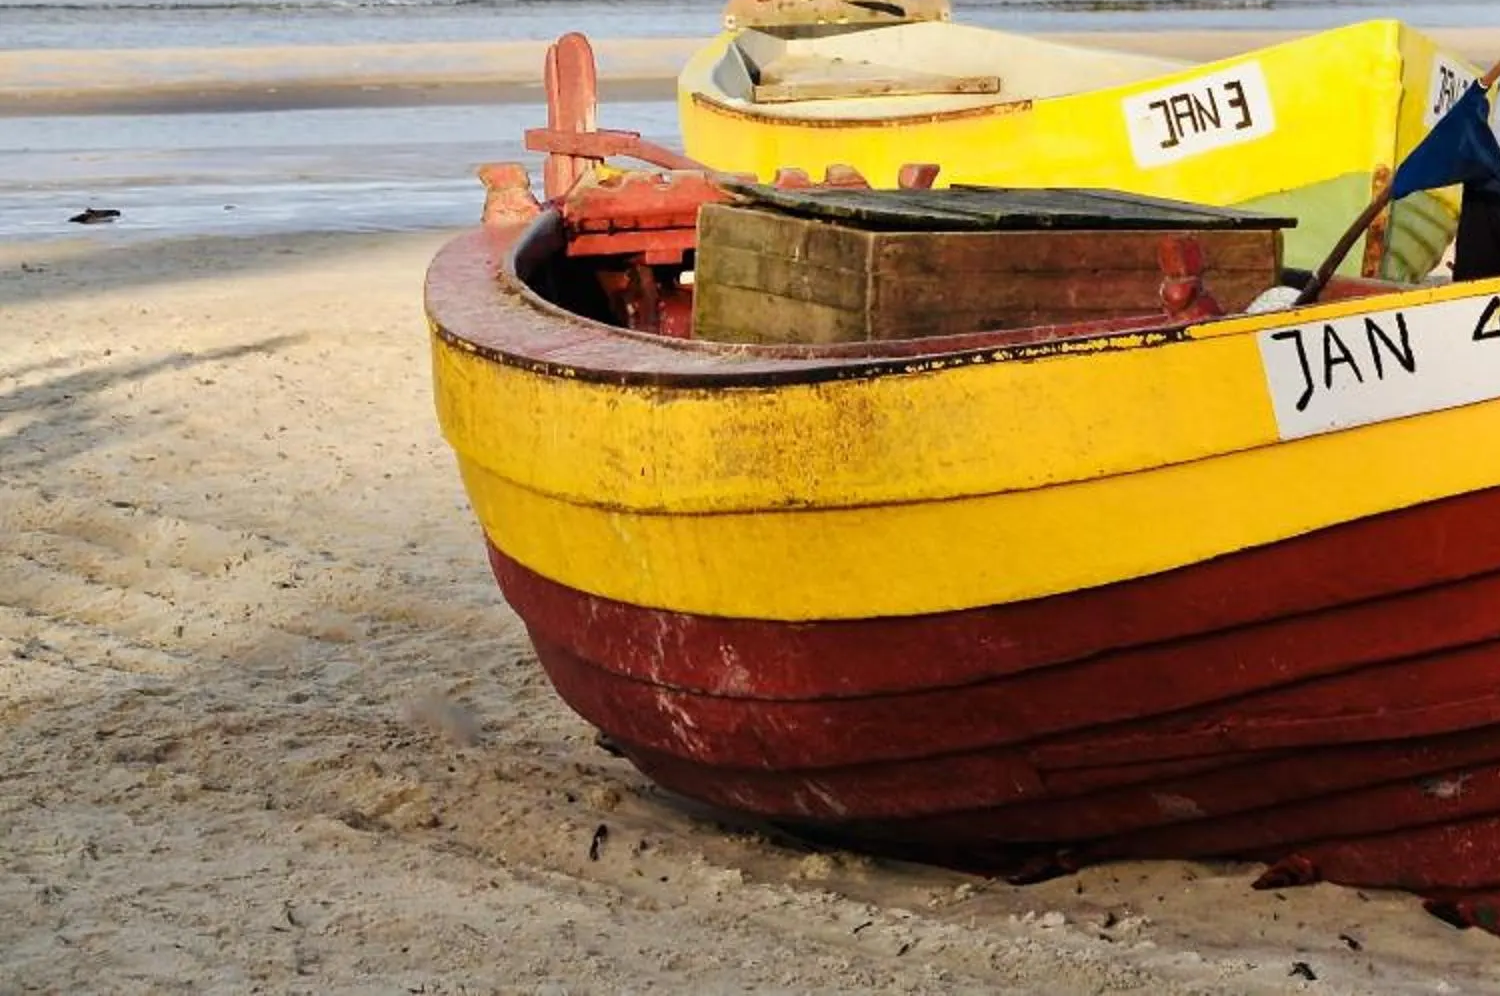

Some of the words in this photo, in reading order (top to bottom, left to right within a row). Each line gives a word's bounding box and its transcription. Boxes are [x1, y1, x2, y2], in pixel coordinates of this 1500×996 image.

[1149, 87, 1221, 149] JAN
[1224, 80, 1253, 131] 3
[1271, 312, 1416, 412] JAN
